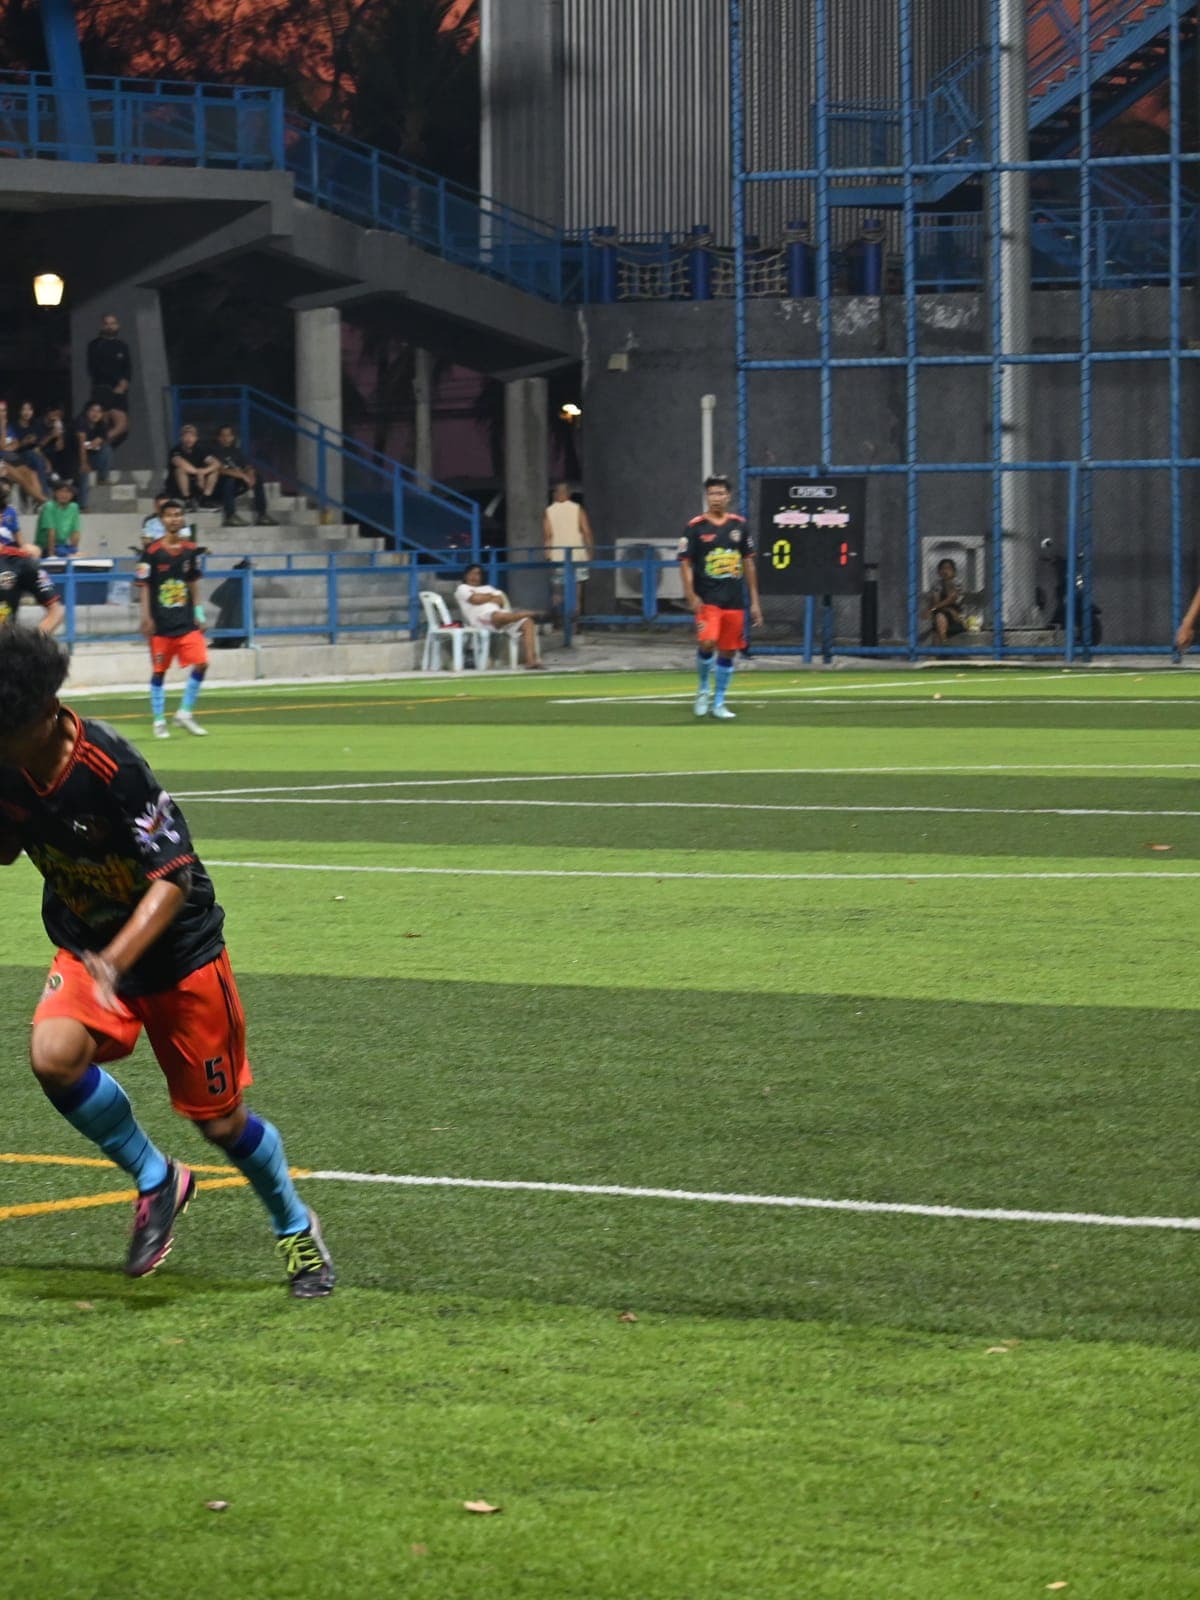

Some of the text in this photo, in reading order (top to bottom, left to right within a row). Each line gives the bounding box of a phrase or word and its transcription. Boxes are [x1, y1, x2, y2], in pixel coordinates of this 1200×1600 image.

[773, 540, 790, 569] 0
[840, 542, 848, 566] 1
[204, 1056, 227, 1095] 5
